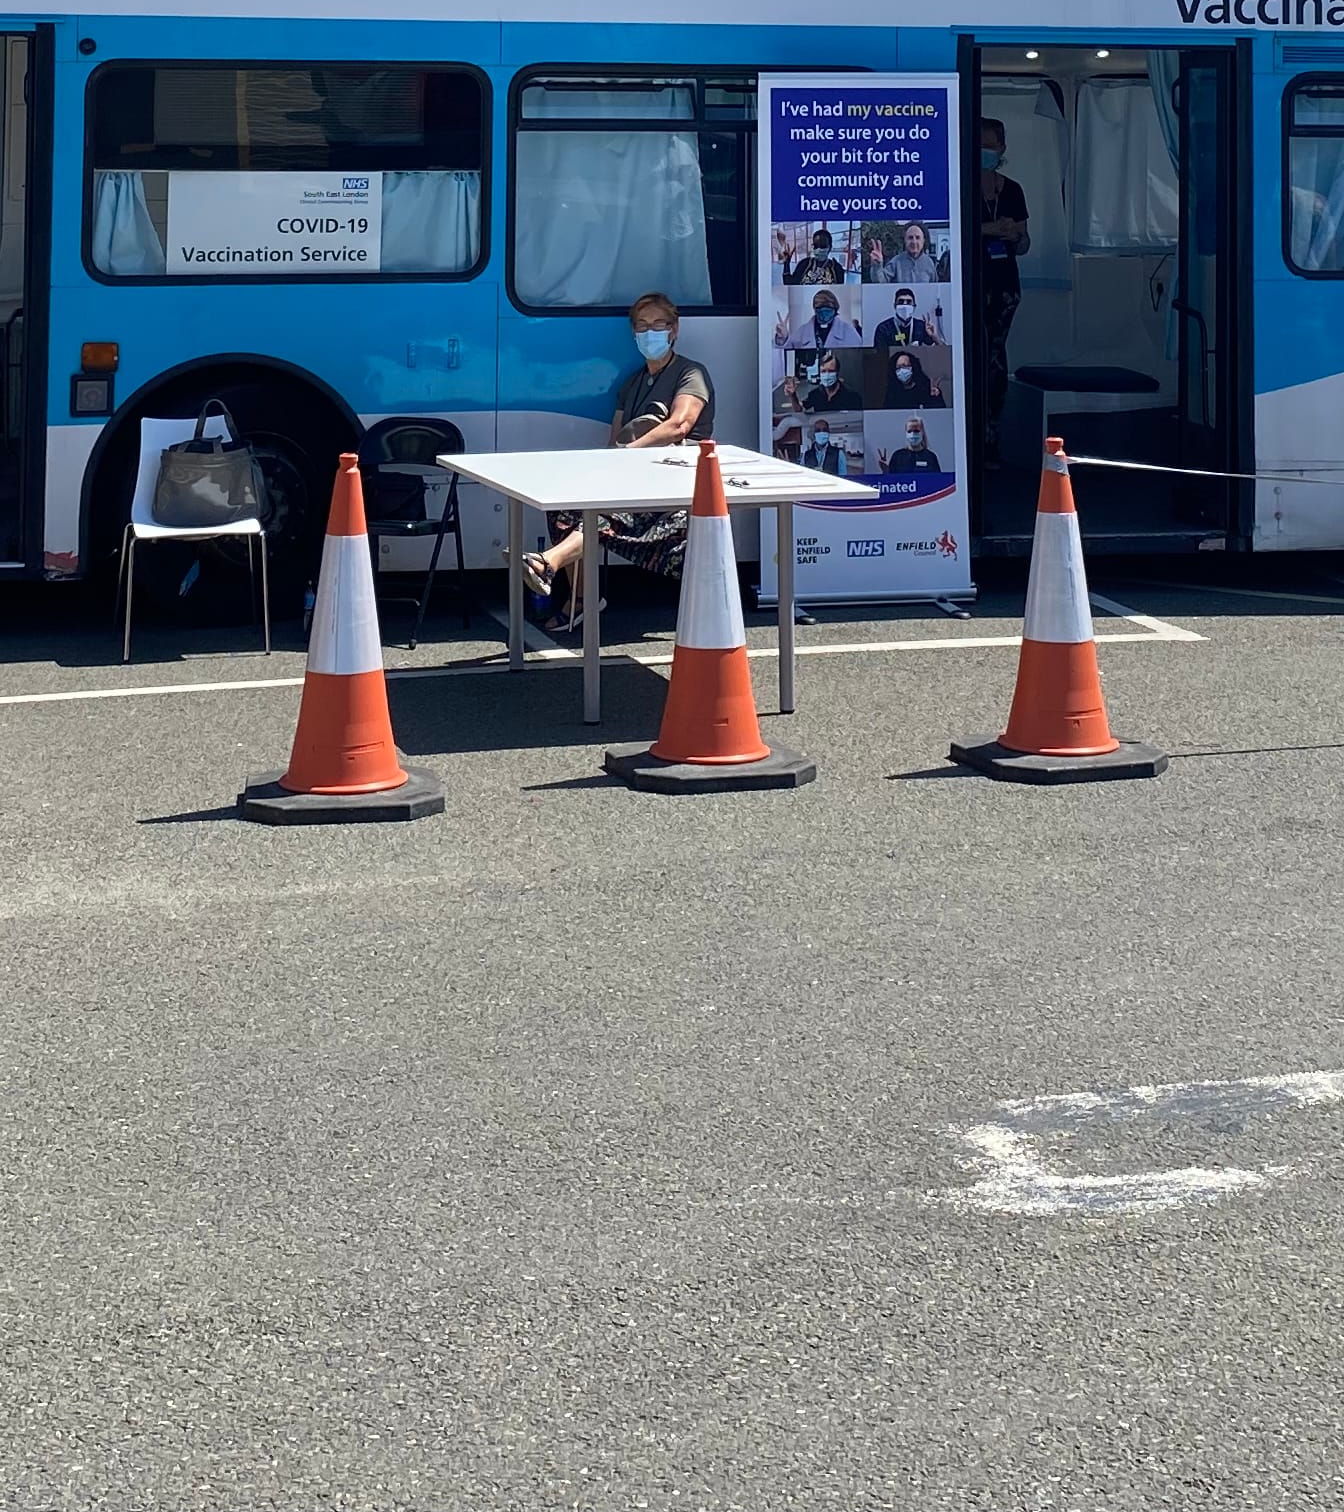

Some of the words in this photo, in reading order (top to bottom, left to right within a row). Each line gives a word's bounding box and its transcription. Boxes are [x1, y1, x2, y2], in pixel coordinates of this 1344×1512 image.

[813, 101, 842, 116] had
[848, 105, 871, 120] my
[876, 102, 938, 118] vaccine,
[790, 125, 834, 139] make
[838, 129, 870, 139] sure
[875, 128, 905, 143] you
[909, 125, 929, 139] do
[801, 151, 837, 167] your
[842, 148, 862, 163] bit
[867, 148, 889, 163] for
[893, 148, 919, 163] the
[344, 180, 368, 188] NHS
[798, 173, 889, 190] community
[893, 172, 923, 186] and
[800, 196, 838, 211] have
[843, 198, 886, 214] yours
[891, 197, 922, 210] too.
[277, 218, 368, 234] COVID-19
[182, 247, 293, 262] Vaccination
[301, 246, 367, 261] Service
[797, 546, 831, 555] ENFIELD
[849, 542, 882, 556] NHS
[896, 542, 936, 550] ENFIELD
[797, 556, 817, 564] SAFE
